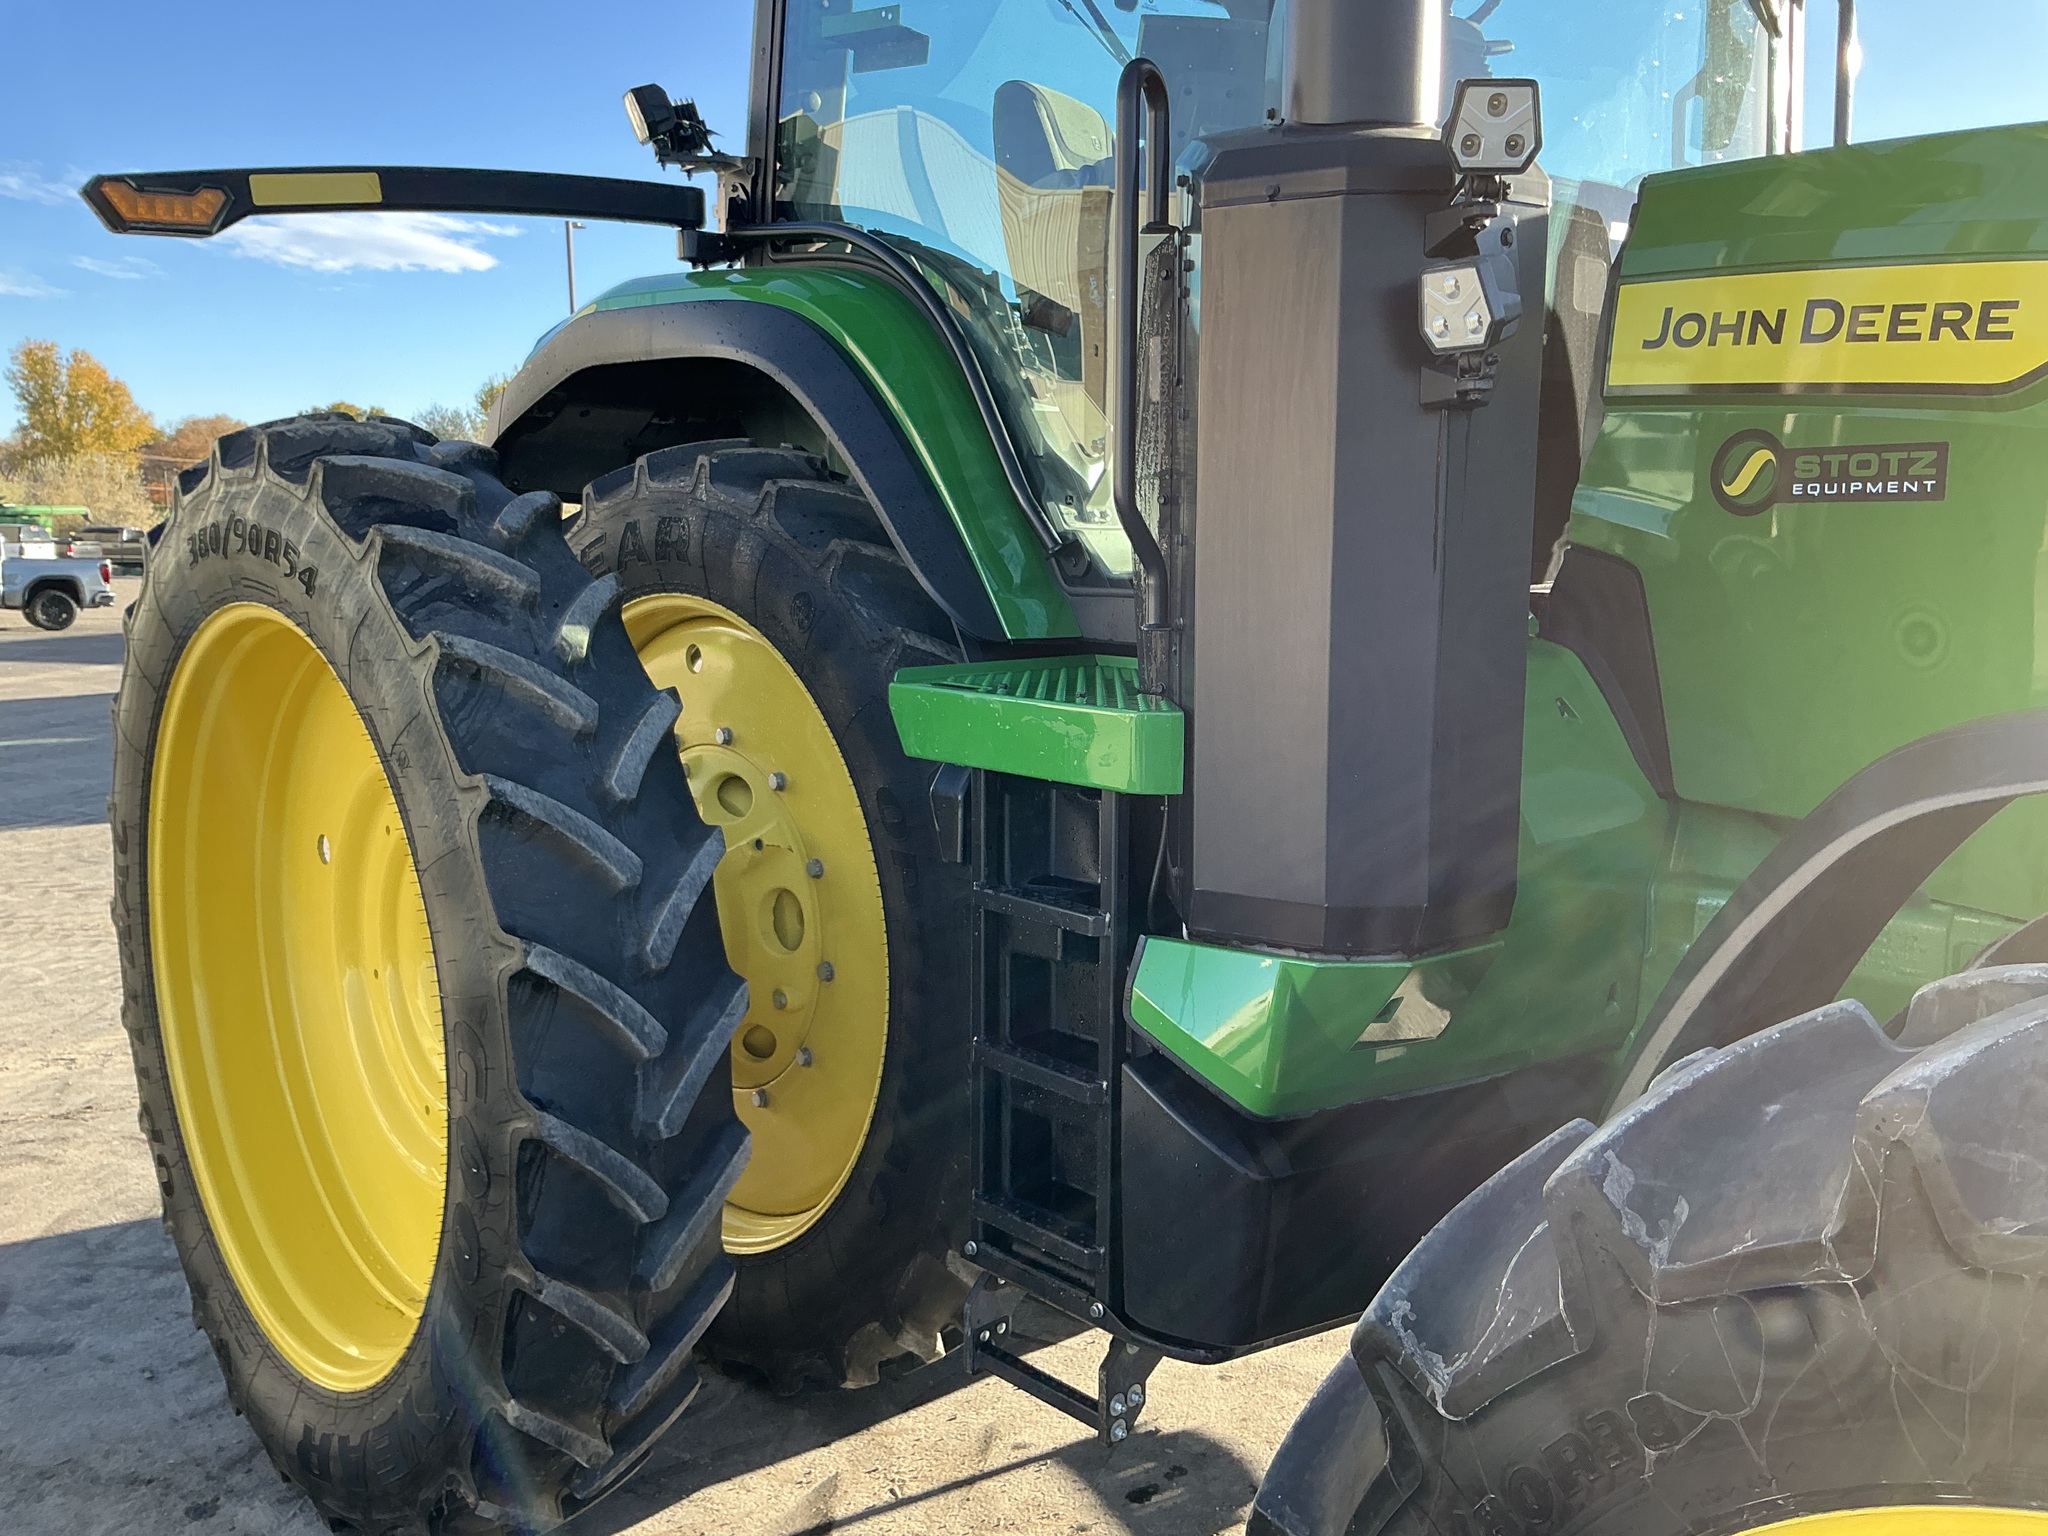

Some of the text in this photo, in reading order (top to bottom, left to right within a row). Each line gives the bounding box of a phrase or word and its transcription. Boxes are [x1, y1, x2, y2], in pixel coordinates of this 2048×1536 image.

[1641, 298, 2020, 350] JOHN DEERE
[1793, 450, 1938, 479] STOTZ
[1792, 479, 1937, 496] EQUIPMENT
